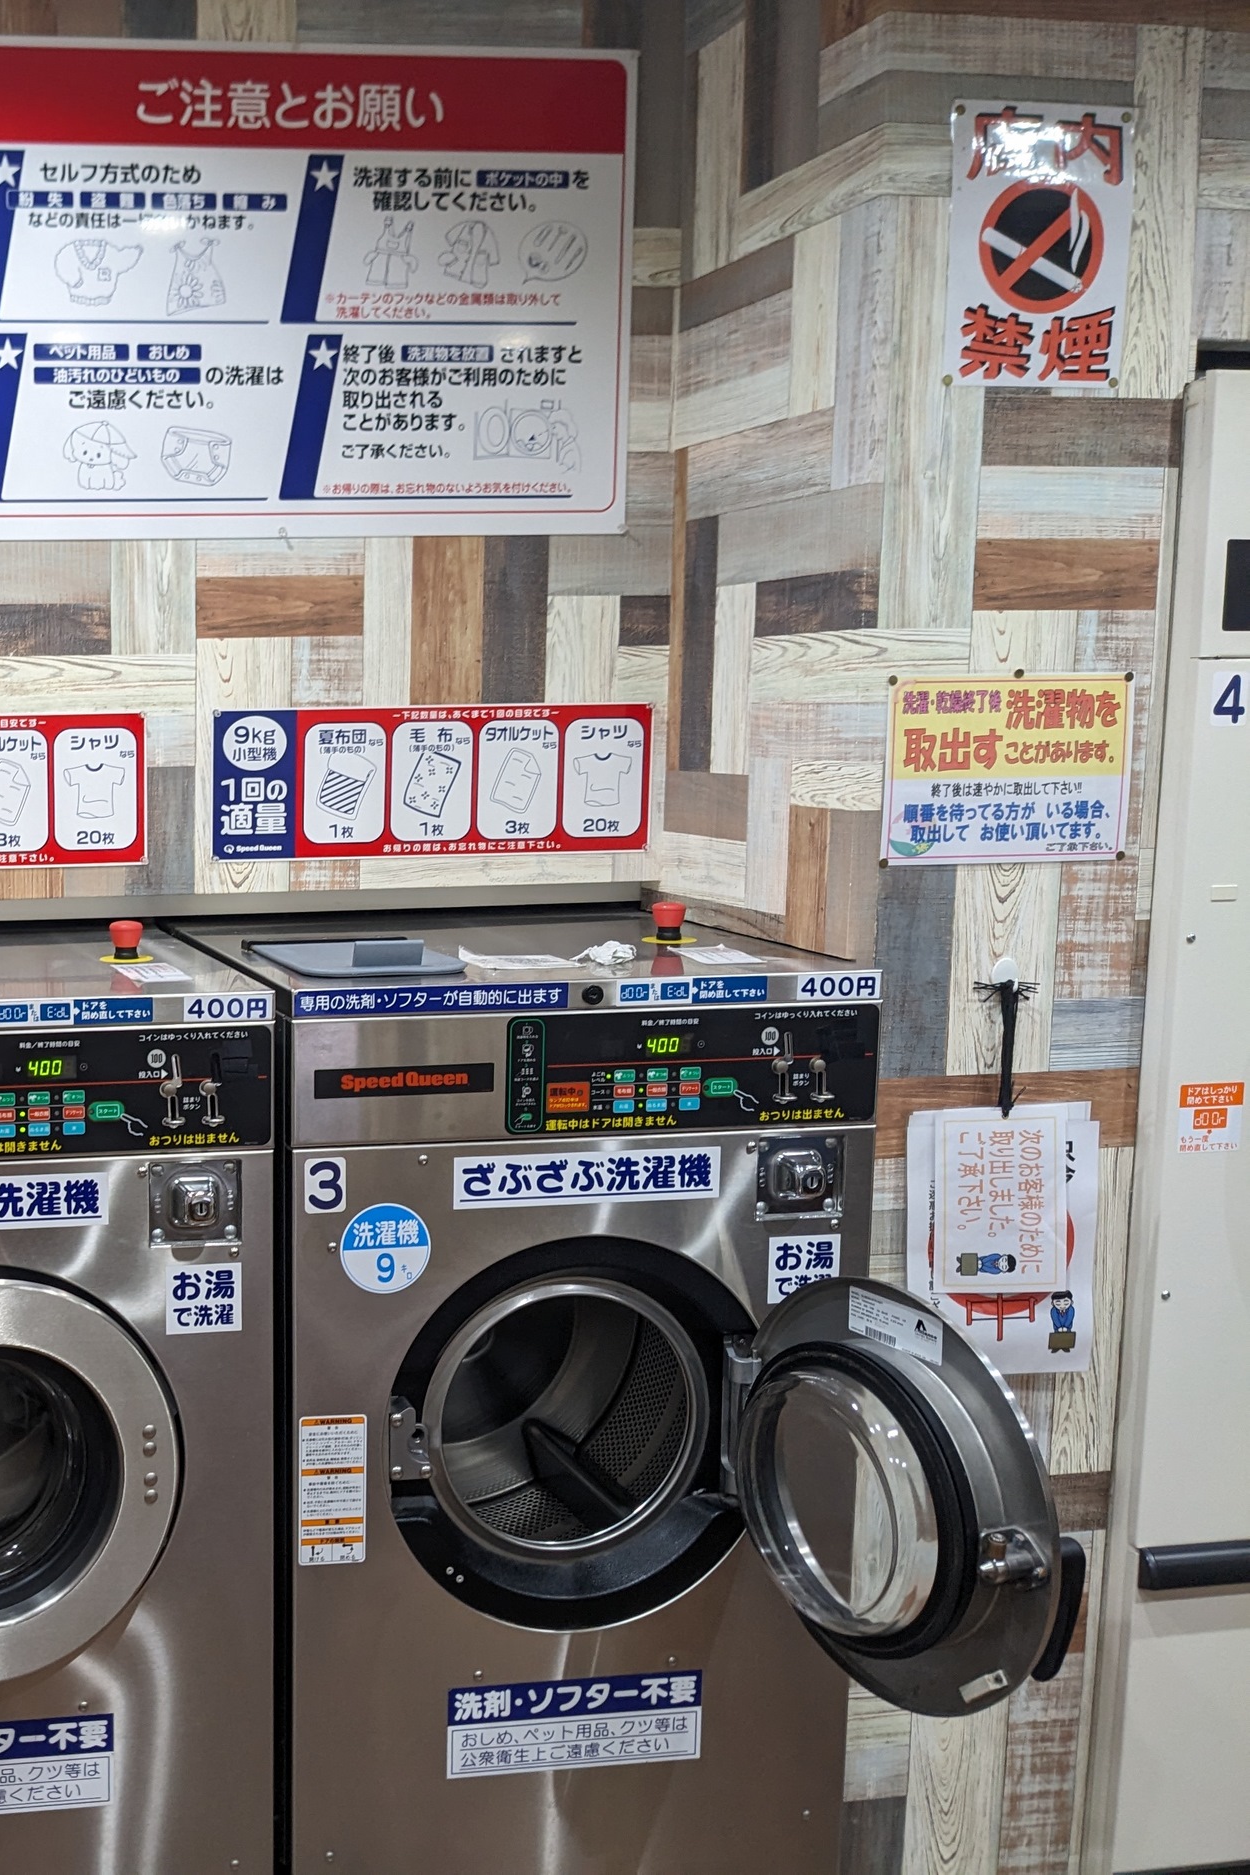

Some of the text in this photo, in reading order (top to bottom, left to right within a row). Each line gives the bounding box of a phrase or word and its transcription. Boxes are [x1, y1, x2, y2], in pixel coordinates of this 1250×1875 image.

[136, 77, 444, 133] ご注意とお願い
[39, 163, 202, 185] セルフ方式のため
[353, 166, 471, 188] 洗濯する前に
[373, 192, 537, 212] 確認してください。
[336, 306, 432, 320] 洗濯してください。
[49, 345, 189, 360] ペット用品 おしめ
[959, 302, 1116, 381] 禁煙
[342, 344, 395, 364] 終了後
[501, 344, 583, 364] されますと
[53, 366, 284, 386] 油汚れのひどいもの の洗濯は
[342, 367, 566, 387] 次のお客様がご利用のために
[68, 389, 215, 411] ご遠慮ください。
[342, 389, 443, 410] 取り出される
[342, 412, 466, 432] ことがあります。
[341, 443, 452, 459] ご了承ください。
[1005, 688, 1121, 730] 洗濯物を
[1213, 674, 1245, 724] 4
[70, 734, 119, 751] シャツ
[234, 725, 276, 746] 9kg
[232, 746, 277, 762] 小型機
[903, 727, 1115, 773] 取出す ことがあります。
[220, 777, 288, 802] 1回の
[220, 803, 288, 836] 適量
[903, 799, 1111, 823] 順番を待ってる方が いる場合、
[76, 830, 115, 845] 20枚
[910, 821, 1102, 844] 取出して お使い頂いてます。
[801, 976, 877, 998] 400円
[187, 998, 267, 1019] 400円
[646, 1037, 680, 1053] 400
[28, 1059, 62, 1075] 400
[341, 1071, 468, 1092] Speed Queen
[1187, 1085, 1238, 1096] ドアはしっかり
[1186, 1095, 1233, 1105] 閉めて下さい
[308, 1161, 343, 1209] 3
[462, 1153, 711, 1196] ざぶざぶ洗濯機
[353, 1218, 420, 1248] 洗濯機
[775, 1241, 833, 1271] お湯
[377, 1252, 395, 1283] 9
[173, 1269, 235, 1301] お湯
[173, 1304, 234, 1327] で洗濯
[454, 1675, 698, 1721] 洗剤・ソフター不要
[461, 1715, 688, 1747] おしめ、ペット用品、クツ等は
[460, 1737, 670, 1767] 公衆衛生上ご遠慮ください
